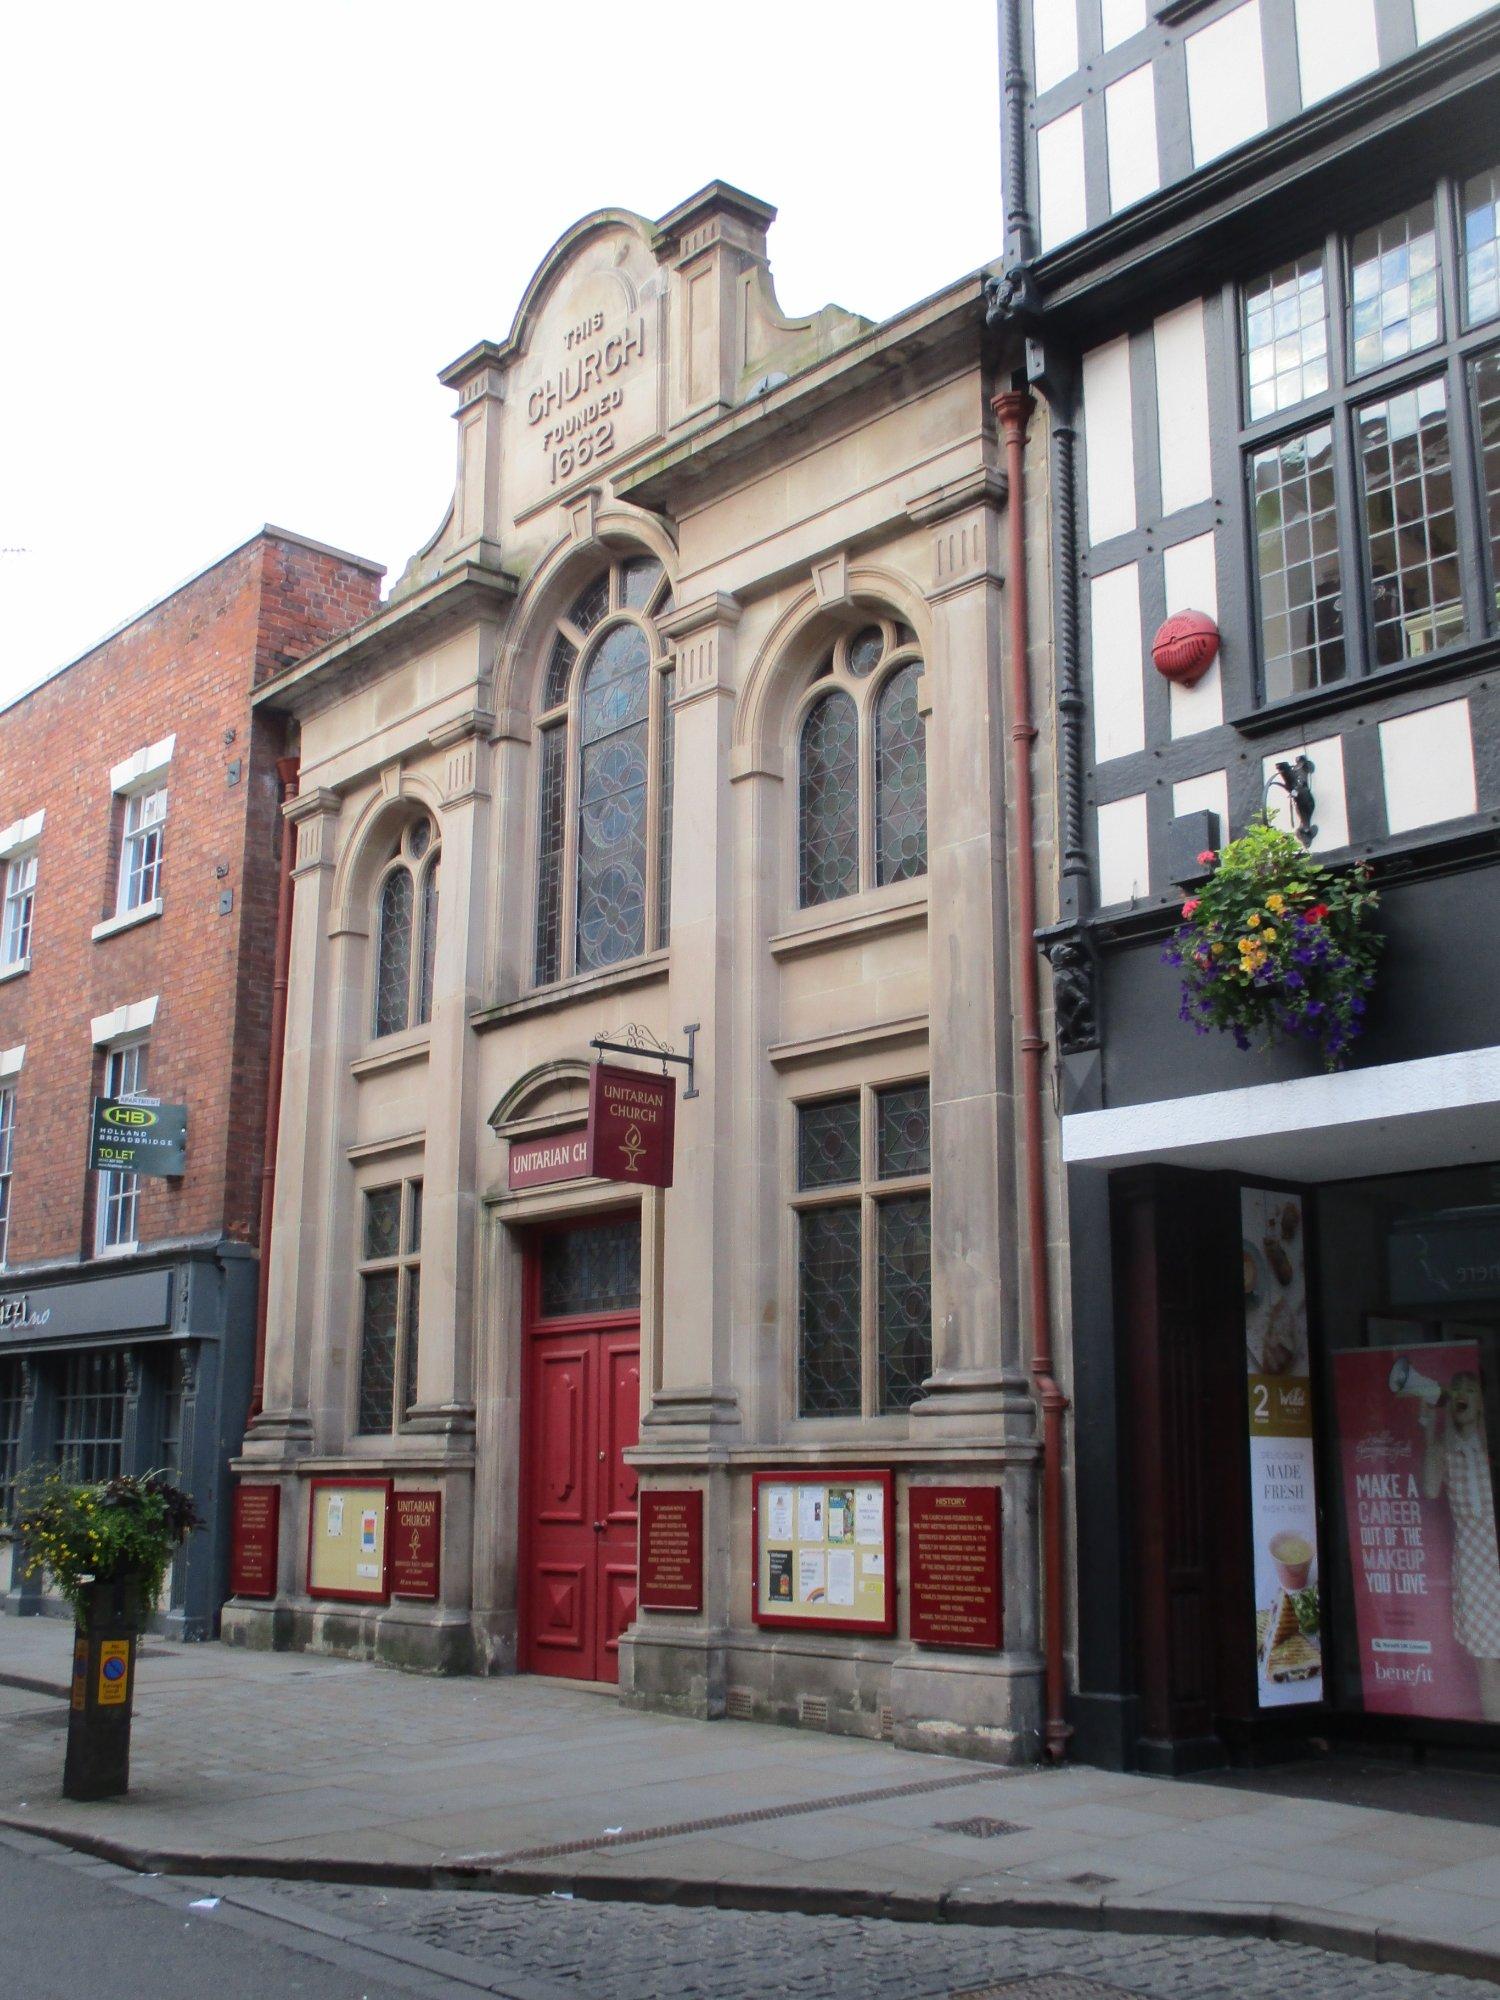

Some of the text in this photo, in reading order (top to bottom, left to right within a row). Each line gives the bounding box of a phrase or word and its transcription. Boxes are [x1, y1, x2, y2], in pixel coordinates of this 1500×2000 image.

[564, 312, 604, 350] THIS
[528, 317, 644, 426] CHURCH
[543, 387, 624, 452] FOUNDED
[550, 420, 616, 485] 1662
[603, 1085, 663, 1107] UNITARIAN
[115, 1110, 145, 1123] HB
[609, 1103, 657, 1123] CHURCH
[99, 1135, 173, 1146] BROADBRIDGE
[100, 1128, 147, 1138] HOLLAND
[99, 1148, 136, 1160] TO LET
[513, 1148, 570, 1174] UNITARIAN
[1254, 1384, 1269, 1416] 2
[1265, 1463, 1302, 1479] MADE
[1264, 1484, 1304, 1499] FRESH
[1355, 1474, 1419, 1498] MAKE A
[397, 1500, 435, 1512] UNITARIAN
[935, 1496, 967, 1506] HISTORY
[401, 1514, 431, 1527] CHURCH
[1358, 1501, 1422, 1525] CAREER
[1360, 1527, 1424, 1546] OUT OF THE
[1362, 1549, 1425, 1570] MAKEUP
[1365, 1572, 1429, 1594] YOU LOVE
[1374, 1661, 1432, 1686] benefit
